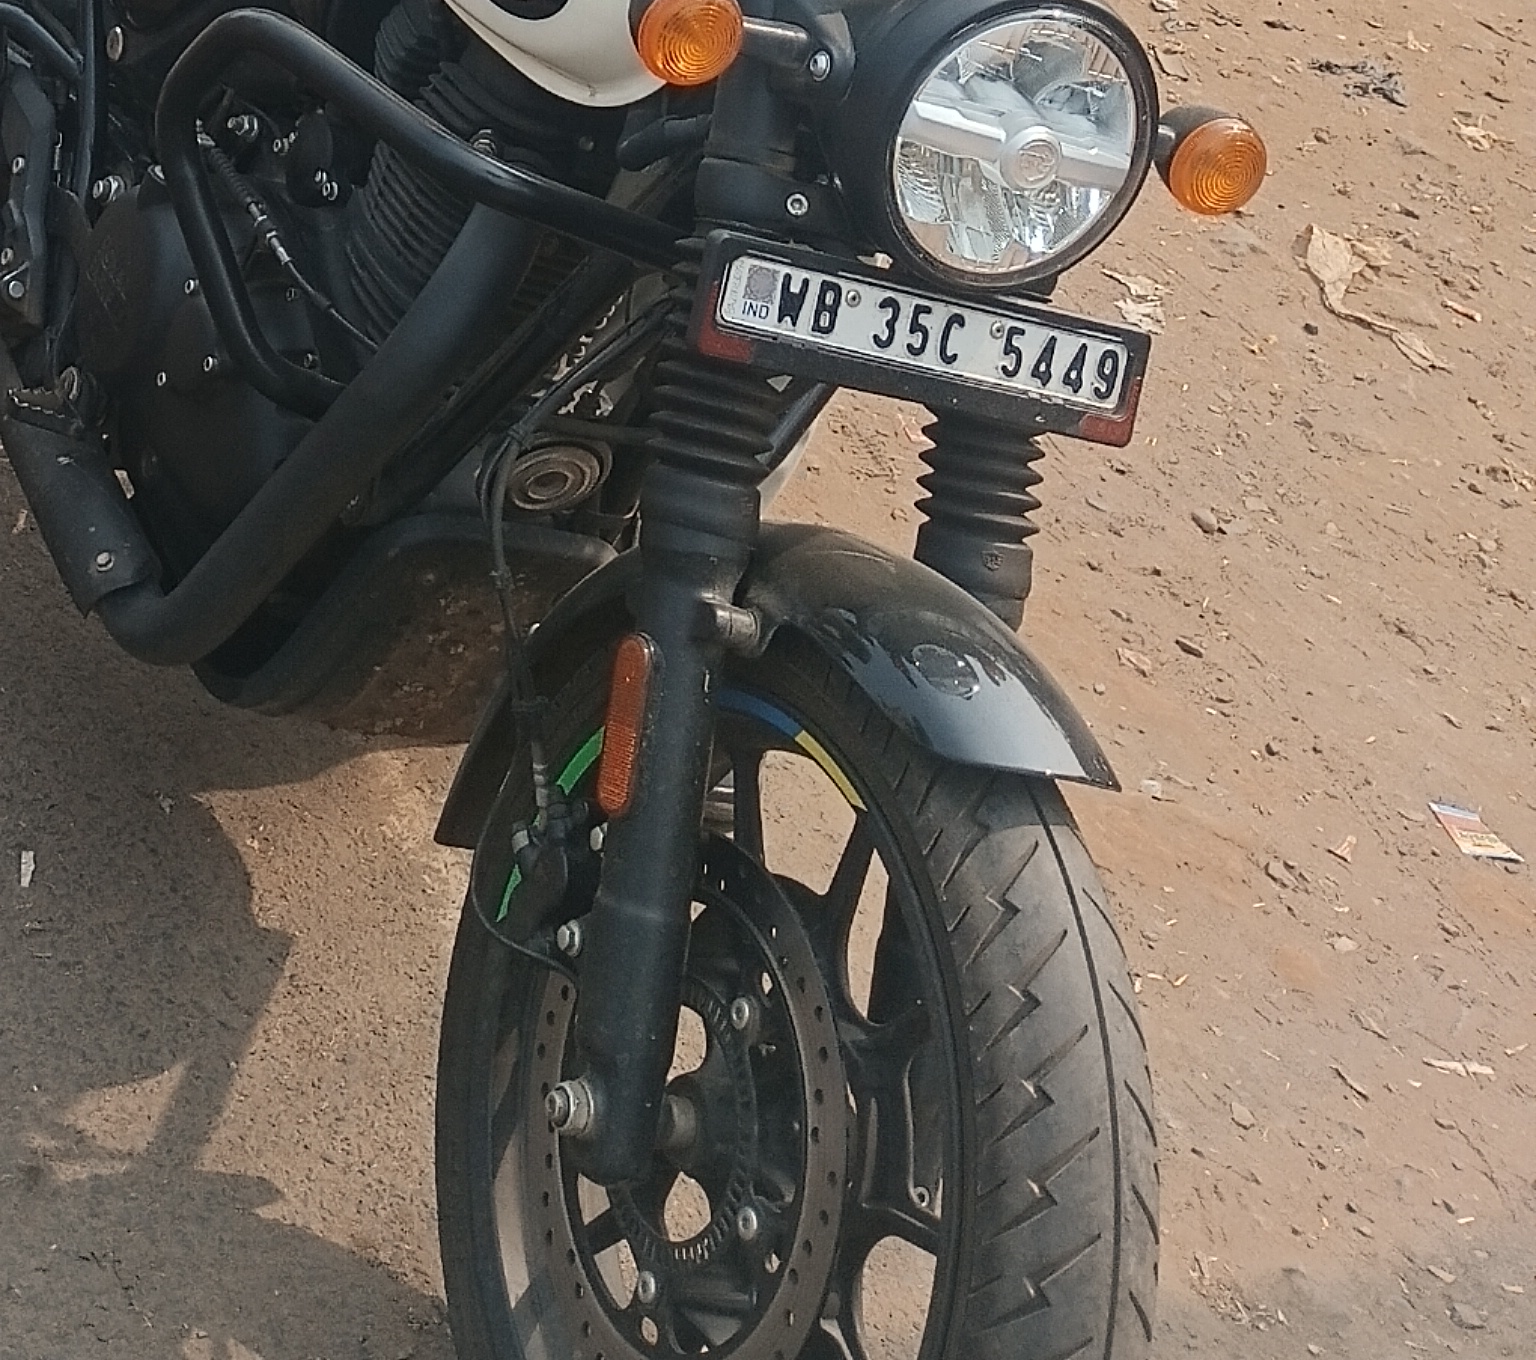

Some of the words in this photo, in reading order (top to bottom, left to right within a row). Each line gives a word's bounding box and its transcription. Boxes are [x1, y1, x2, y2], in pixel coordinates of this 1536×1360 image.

[742, 300, 770, 320] IND
[776, 272, 843, 335] WB
[871, 295, 966, 365] 35C
[999, 325, 1121, 400] 5449
